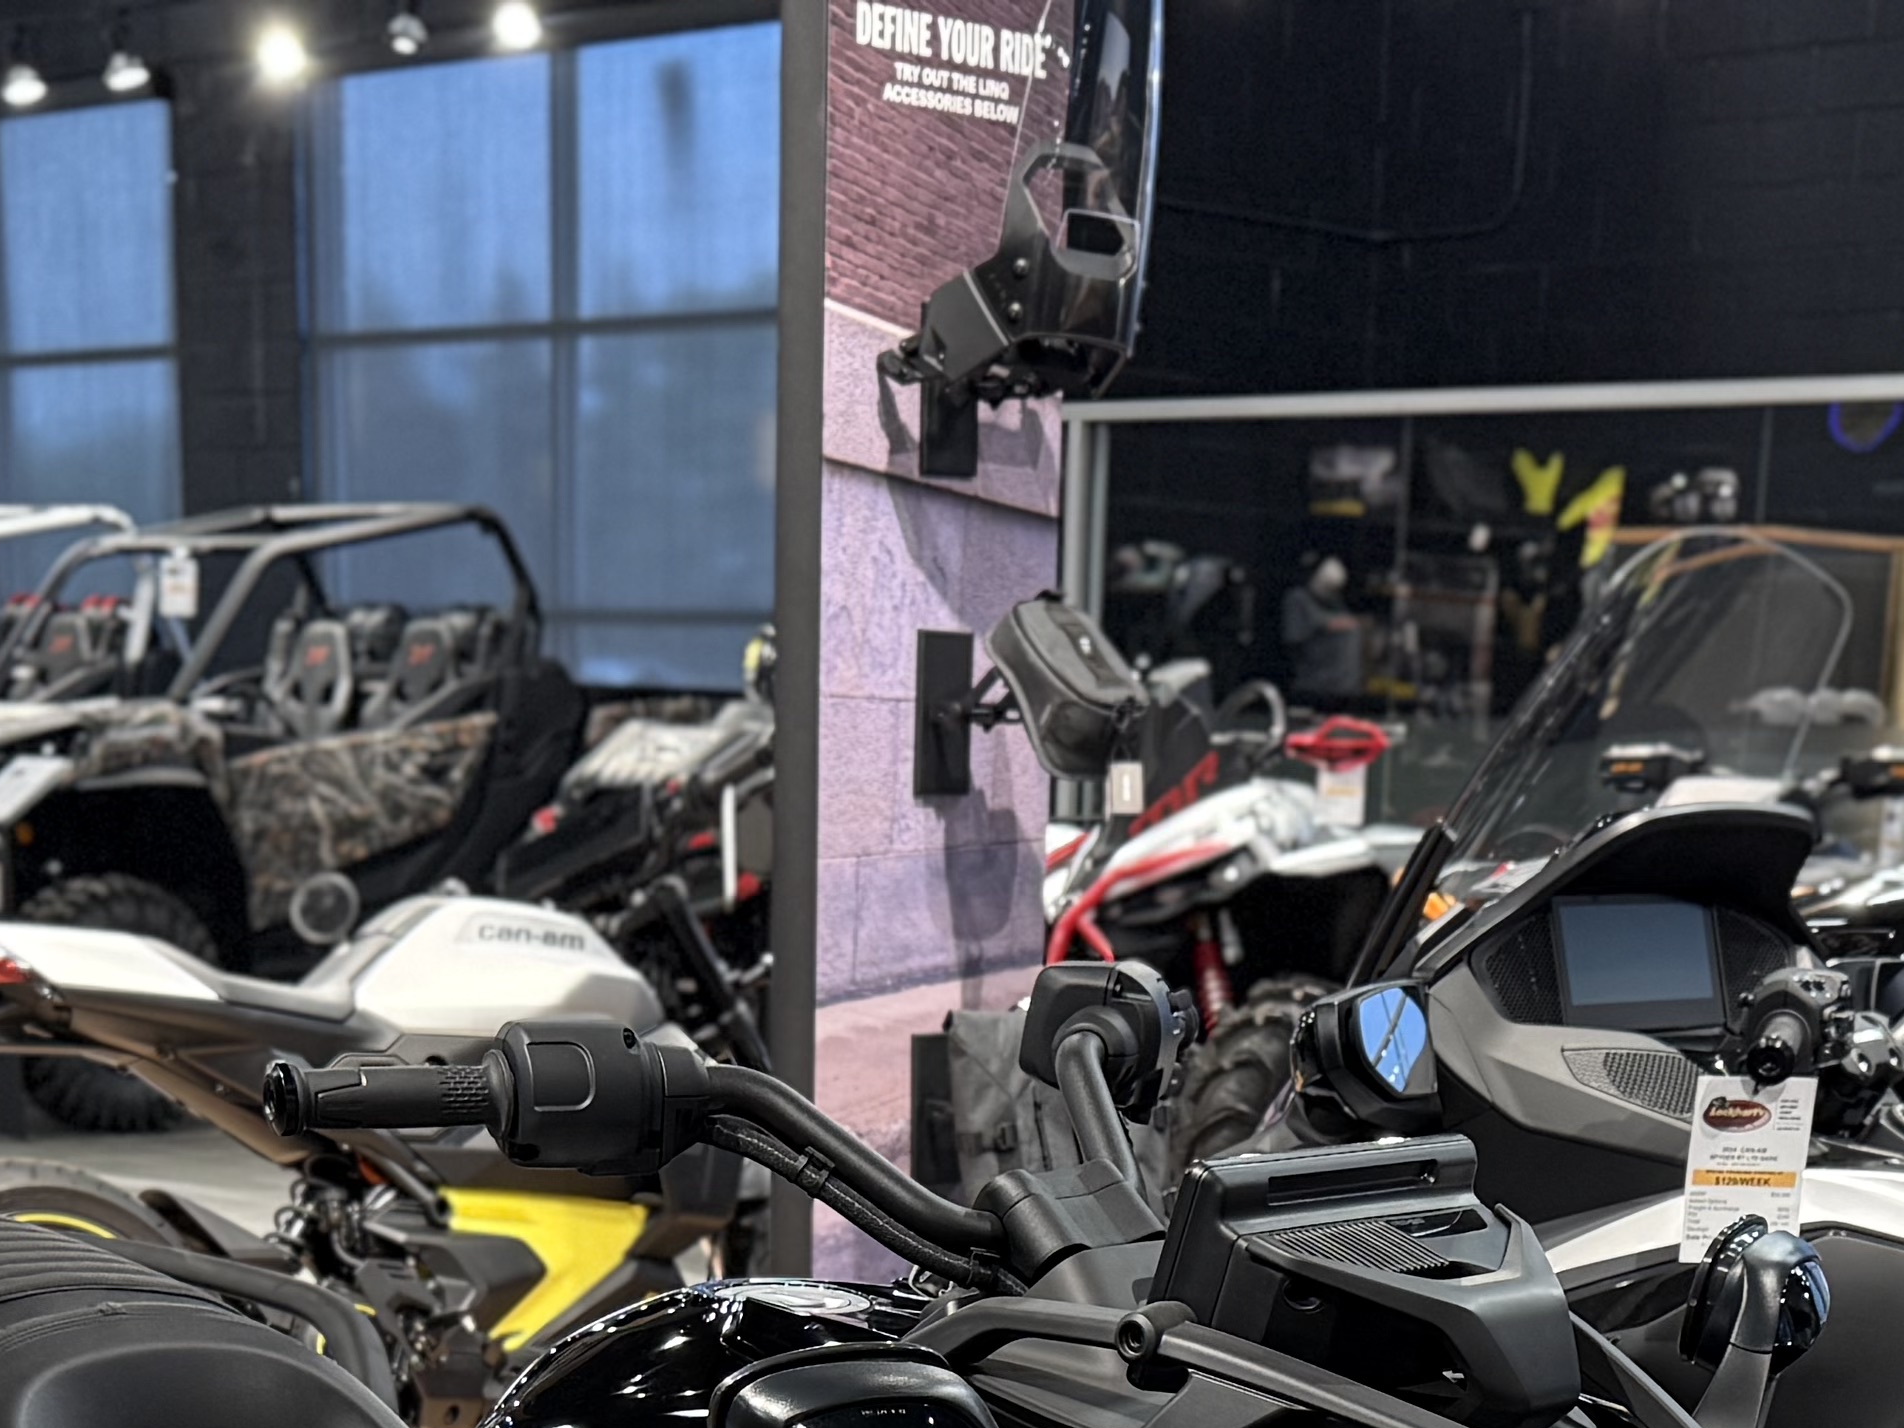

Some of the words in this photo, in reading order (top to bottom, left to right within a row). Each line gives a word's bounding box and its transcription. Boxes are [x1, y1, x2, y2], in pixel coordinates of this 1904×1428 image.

[856, 2, 933, 58] DEFINE
[937, 18, 994, 69] YOUR
[894, 62, 920, 81] TRY
[922, 67, 949, 88] OUT
[951, 72, 976, 92] THE
[882, 82, 973, 116] ACCESSORIES
[974, 100, 1019, 124] BELOW
[478, 924, 585, 951] can-am
